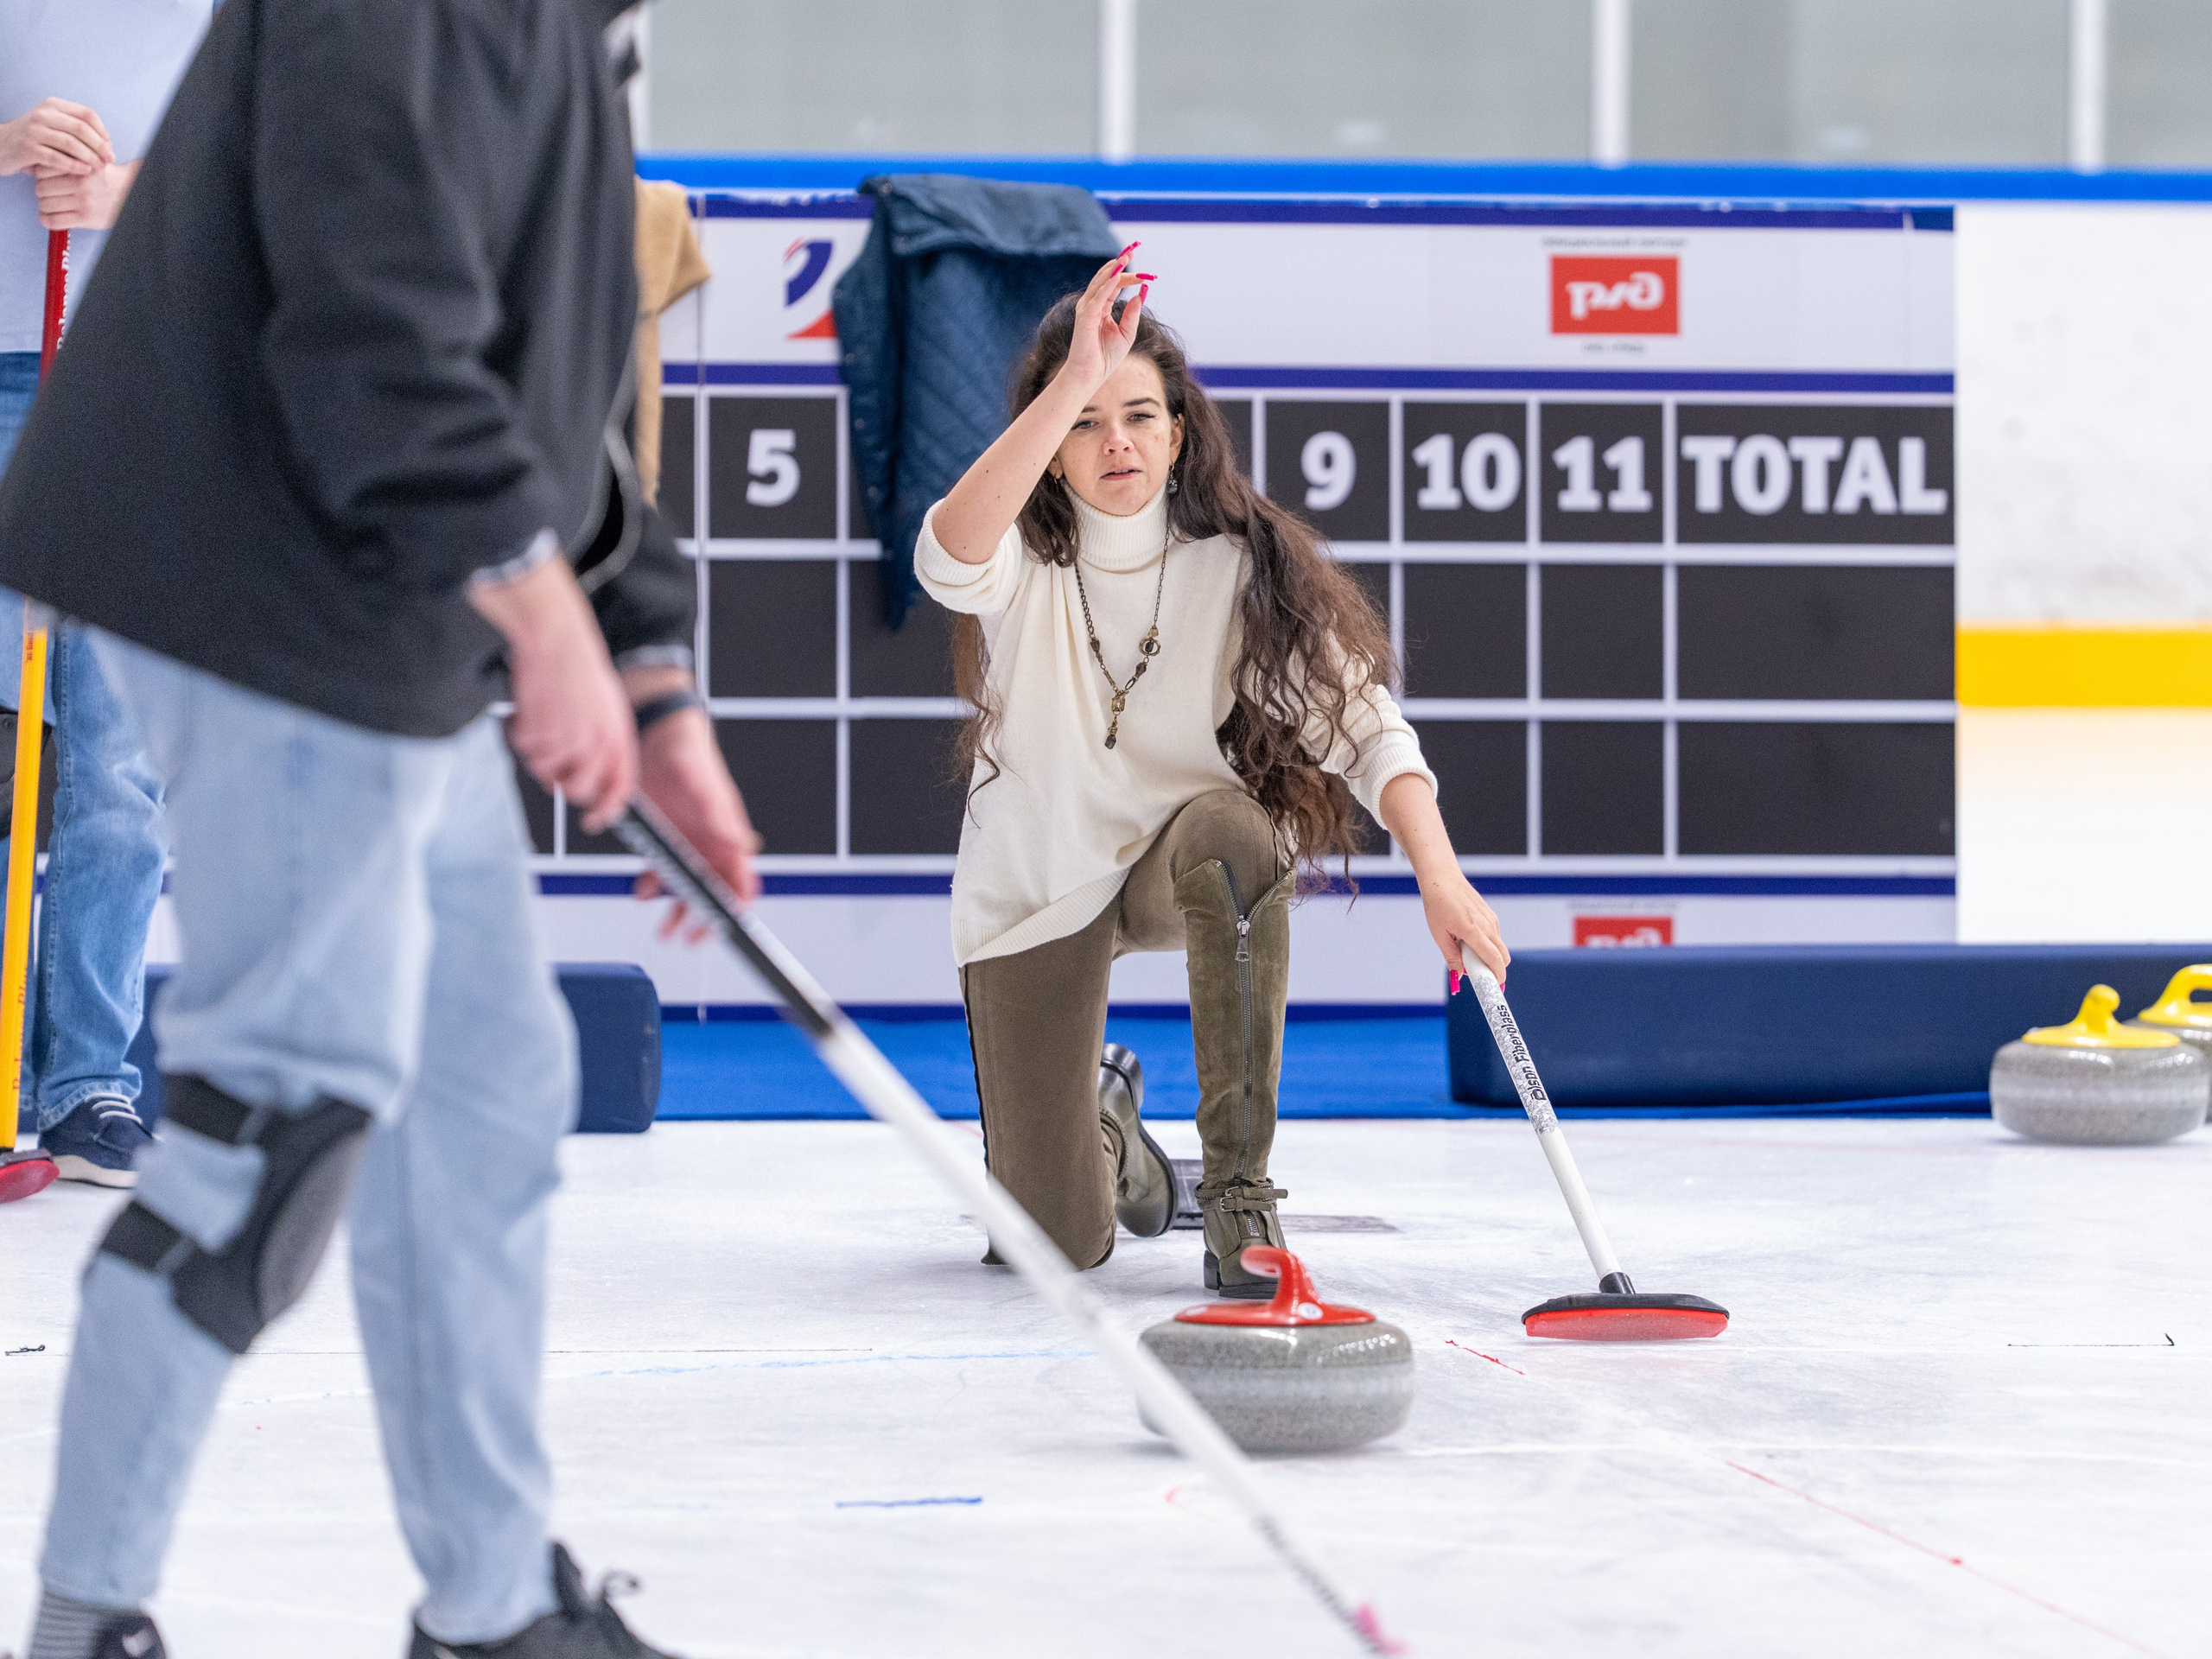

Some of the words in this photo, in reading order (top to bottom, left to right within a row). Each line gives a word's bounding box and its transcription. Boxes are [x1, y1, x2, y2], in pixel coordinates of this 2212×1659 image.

[746, 429, 800, 506] 5
[1300, 431, 1357, 511] 9
[1411, 432, 1522, 512] 10
[1553, 435, 1653, 512] 11
[1681, 434, 1948, 515] TOTAL
[1497, 1004, 1530, 1062] Fiberglass
